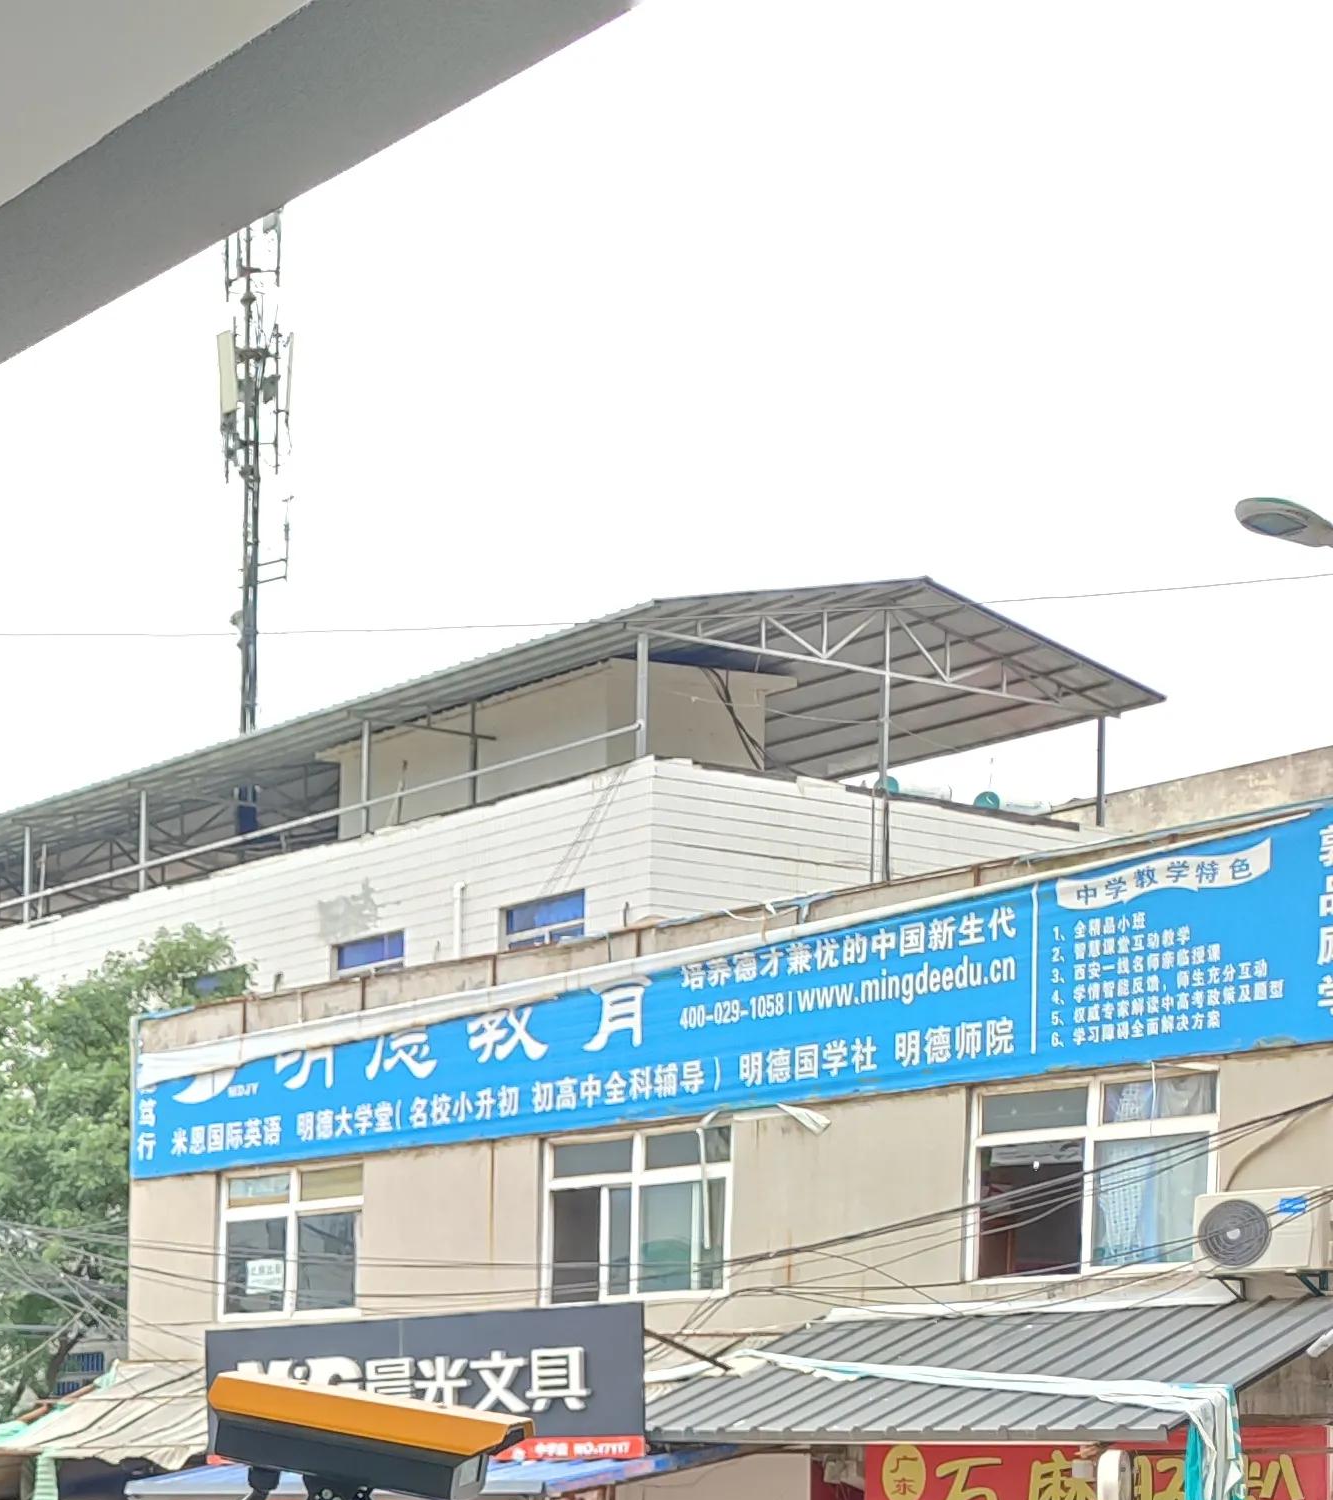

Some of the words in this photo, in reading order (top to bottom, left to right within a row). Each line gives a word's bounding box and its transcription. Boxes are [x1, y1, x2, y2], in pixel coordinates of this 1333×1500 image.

[1077, 858, 1252, 905] 中学教学特色
[681, 906, 1016, 991] 培养德才兼优的中国新生代
[797, 955, 1016, 1013] www.mingdeedu.cn
[171, 1115, 282, 1156] 米恩国际英语
[739, 1036, 877, 1087] 明德国学社
[895, 1016, 1015, 1067] 明德师院
